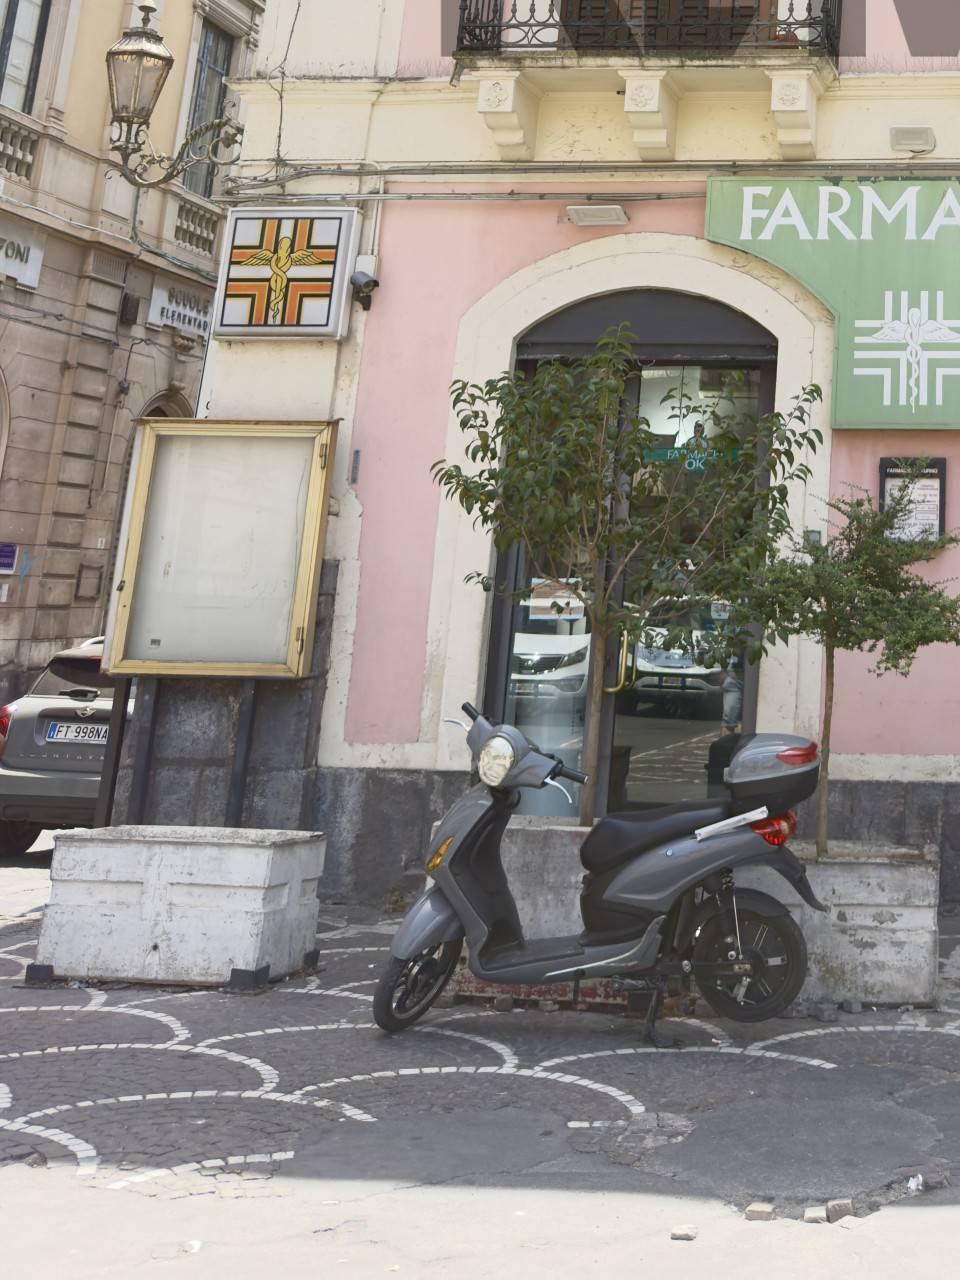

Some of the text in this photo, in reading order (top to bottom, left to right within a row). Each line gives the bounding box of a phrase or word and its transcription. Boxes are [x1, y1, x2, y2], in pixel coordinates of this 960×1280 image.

[168, 287, 210, 317] SCUOLE
[685, 459, 705, 470] OK
[56, 725, 71, 737] FT
[74, 726, 108, 740] 998NA
